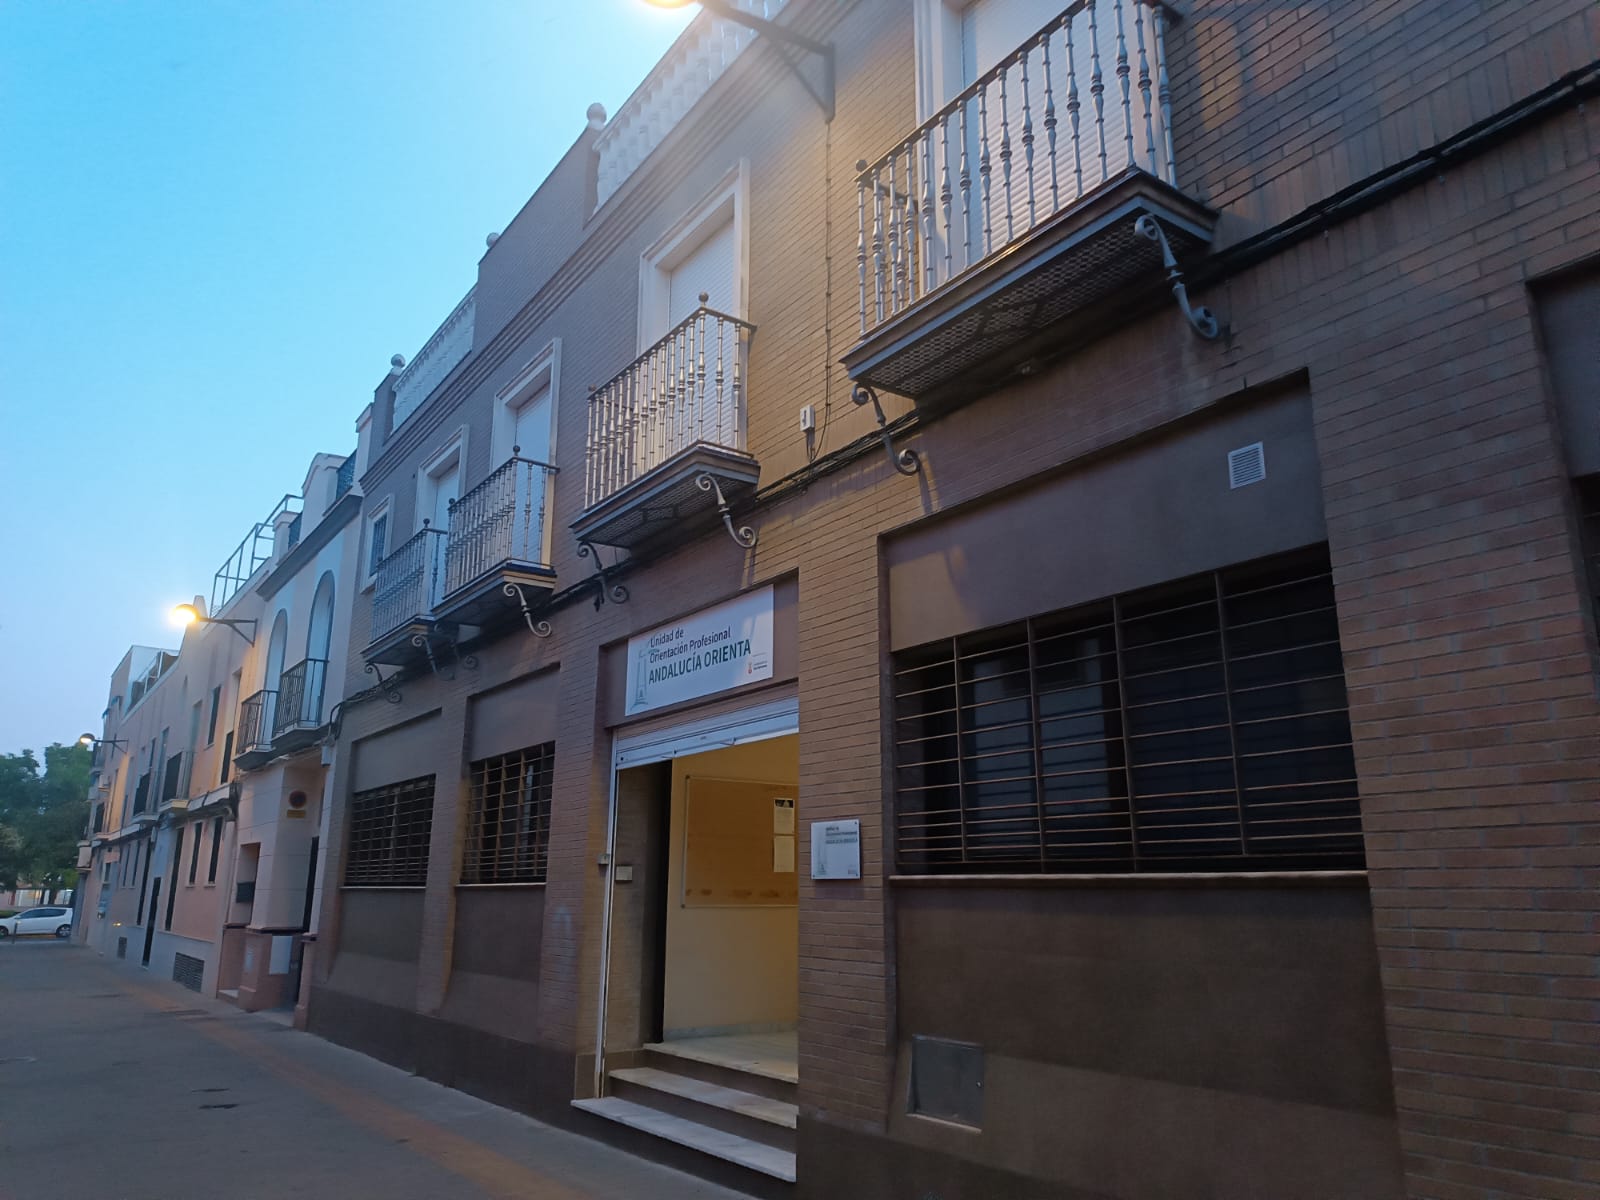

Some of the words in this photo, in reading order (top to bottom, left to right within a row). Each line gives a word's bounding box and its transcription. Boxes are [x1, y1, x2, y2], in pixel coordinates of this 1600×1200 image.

[649, 641, 688, 664] Orientación
[689, 626, 731, 651] Profesional
[650, 629, 674, 648] Unidad
[675, 627, 684, 640] de
[649, 651, 702, 685] ANDALUCÍA
[704, 639, 751, 668] ORIENTA
